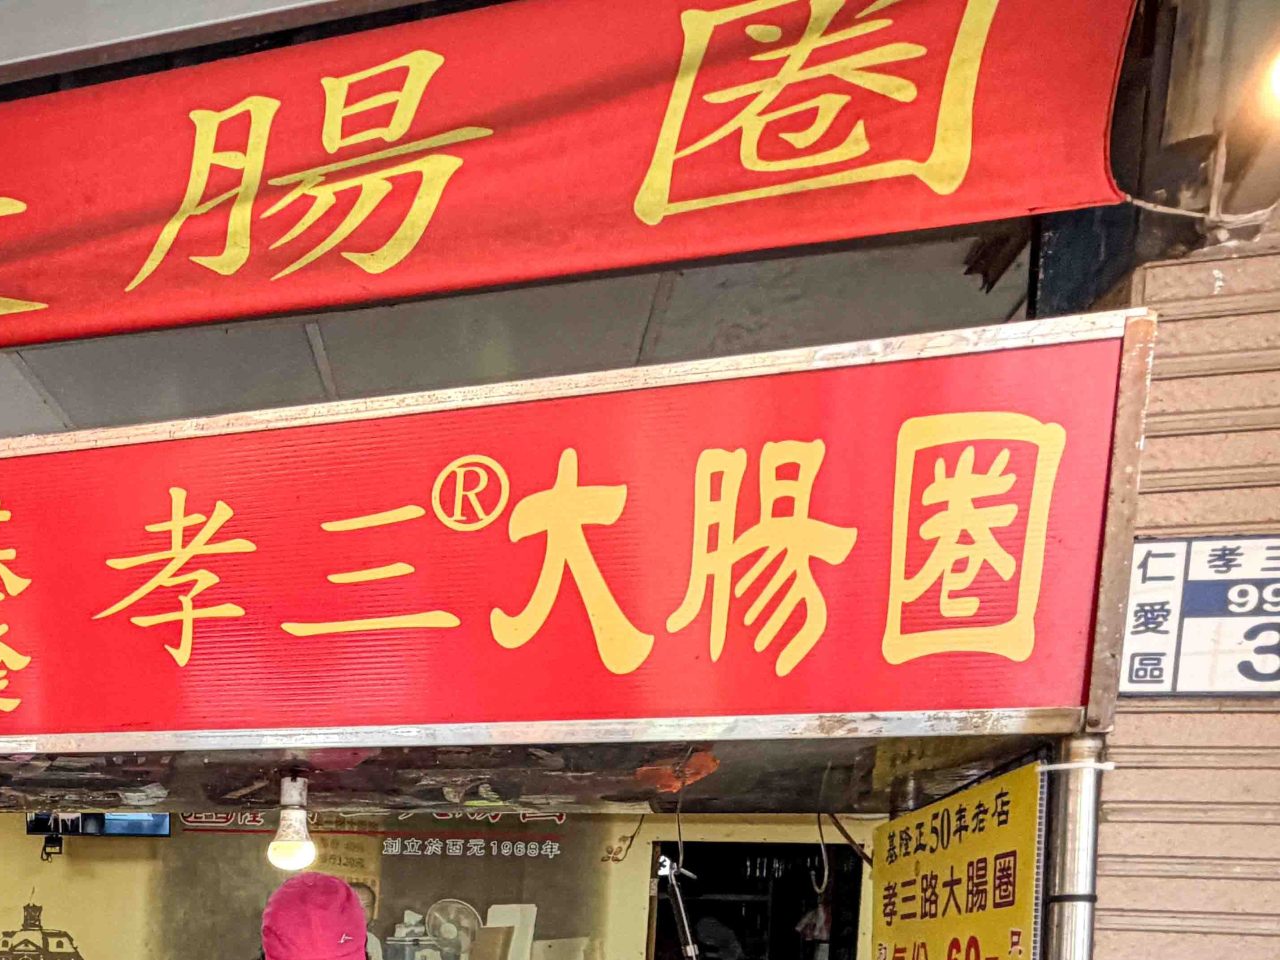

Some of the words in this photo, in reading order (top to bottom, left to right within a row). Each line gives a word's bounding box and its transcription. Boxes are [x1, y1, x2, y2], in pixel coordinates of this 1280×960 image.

[1128, 550, 1176, 684] 仁愛區
[383, 838, 561, 859] 創立於西元1968年
[882, 850, 1017, 927] 孝三路大腸圈
